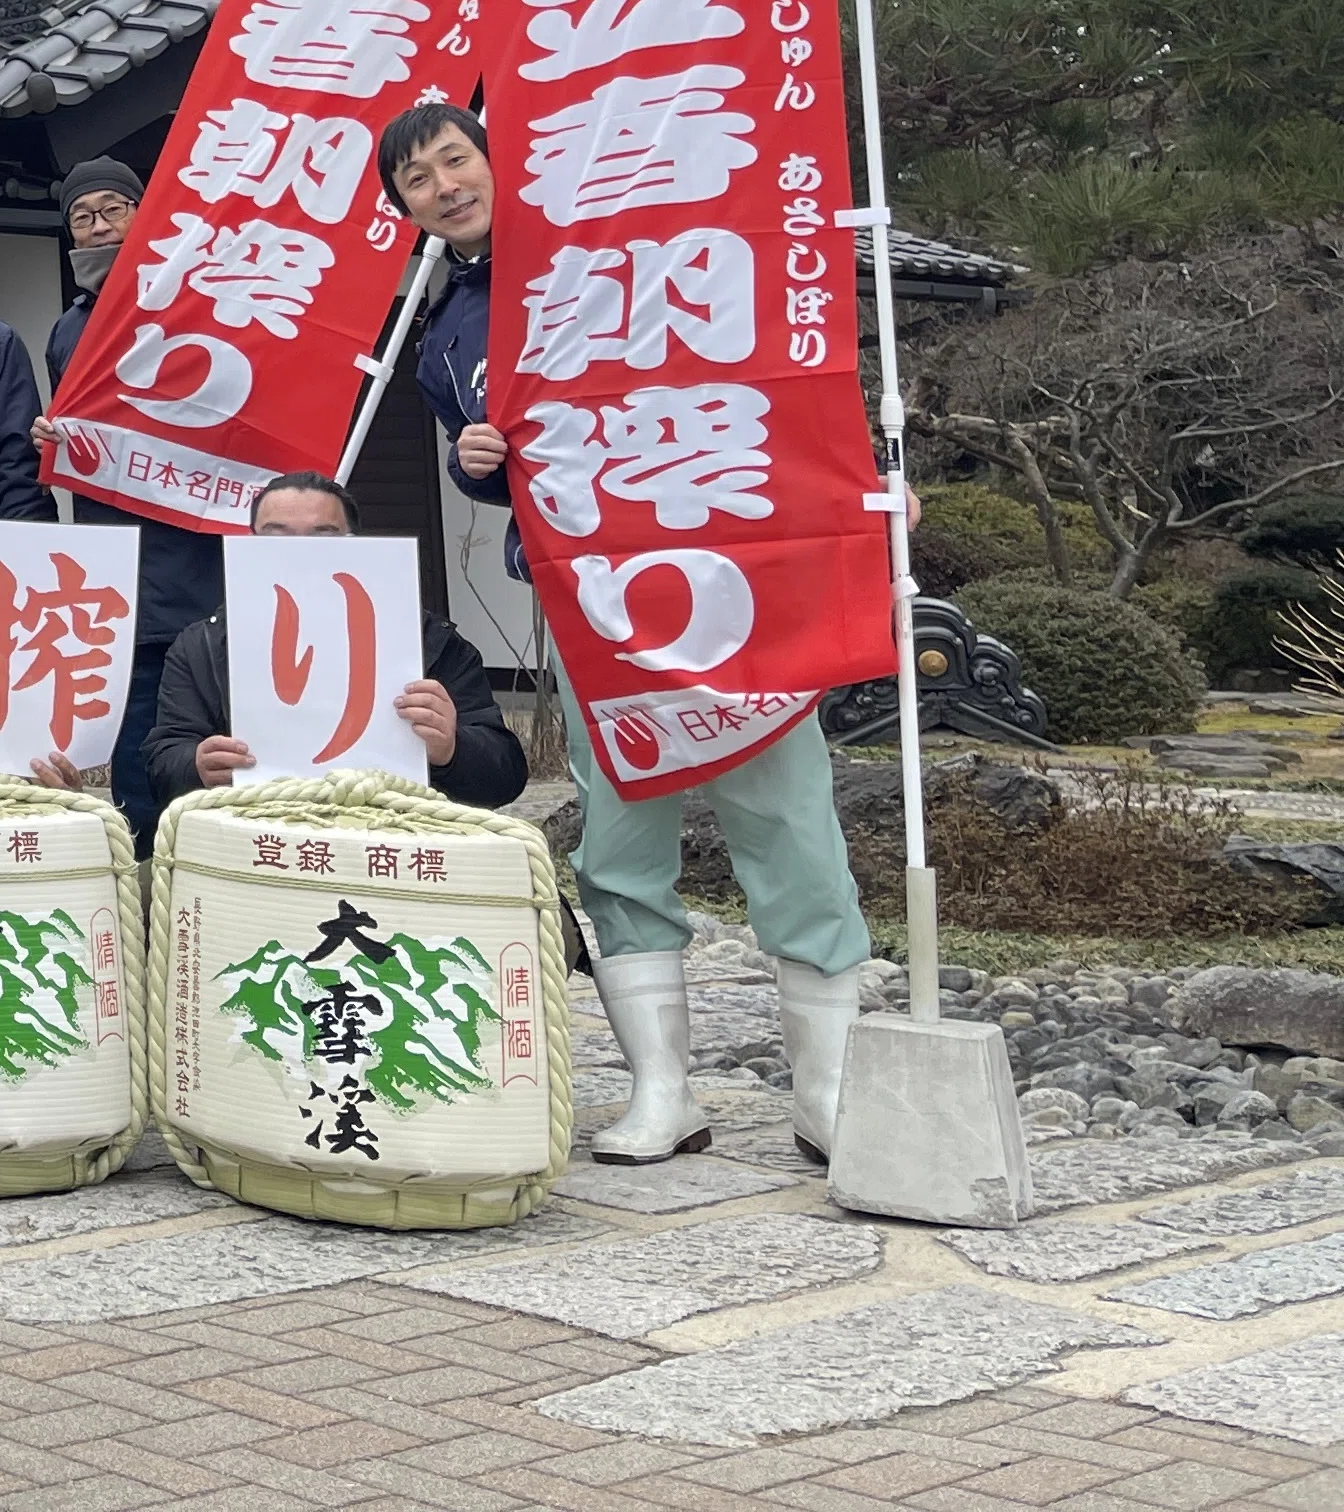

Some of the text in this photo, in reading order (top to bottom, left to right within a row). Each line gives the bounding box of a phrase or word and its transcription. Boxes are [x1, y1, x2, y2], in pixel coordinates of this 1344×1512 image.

[778, 153, 834, 368] あさしぼり
[271, 572, 377, 765] り
[676, 691, 800, 742] 日本名
[252, 834, 448, 883] 登録 商標
[95, 930, 120, 1019] 清酒
[506, 966, 532, 1059] 清酒
